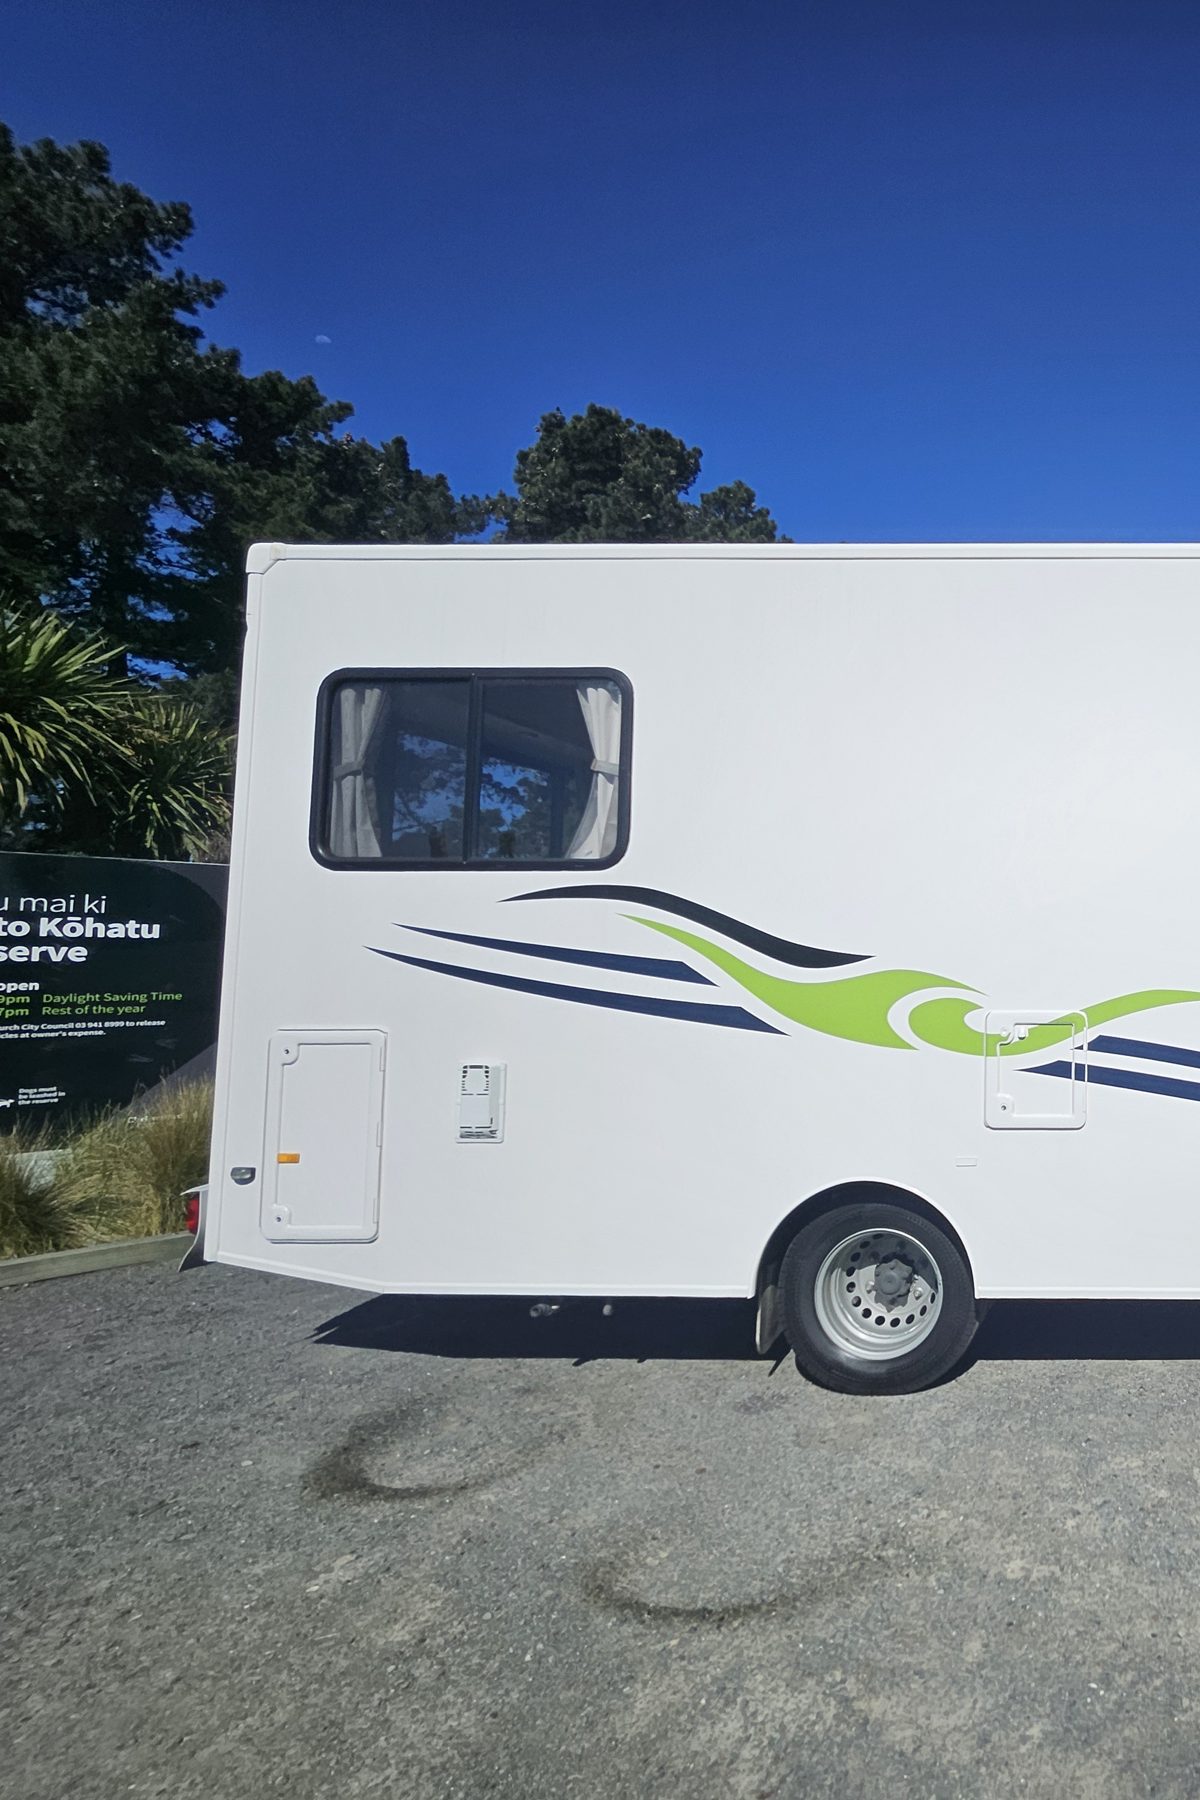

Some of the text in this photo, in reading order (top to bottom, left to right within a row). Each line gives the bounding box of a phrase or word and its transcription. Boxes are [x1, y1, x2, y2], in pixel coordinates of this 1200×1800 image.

[19, 894, 75, 913] mai
[84, 893, 107, 914] ki
[39, 916, 160, 939] Kōhatu
[0, 945, 88, 963] serve
[0, 982, 40, 993] open
[43, 993, 101, 1005] Daylight
[103, 992, 148, 1004] Saving
[150, 991, 183, 1001] Time
[42, 1006, 72, 1015] Rest
[75, 1005, 90, 1015] of
[92, 1005, 114, 1014] the
[116, 1005, 146, 1015] year
[41, 1022, 75, 1030] Council
[68, 1029, 107, 1037] expense.
